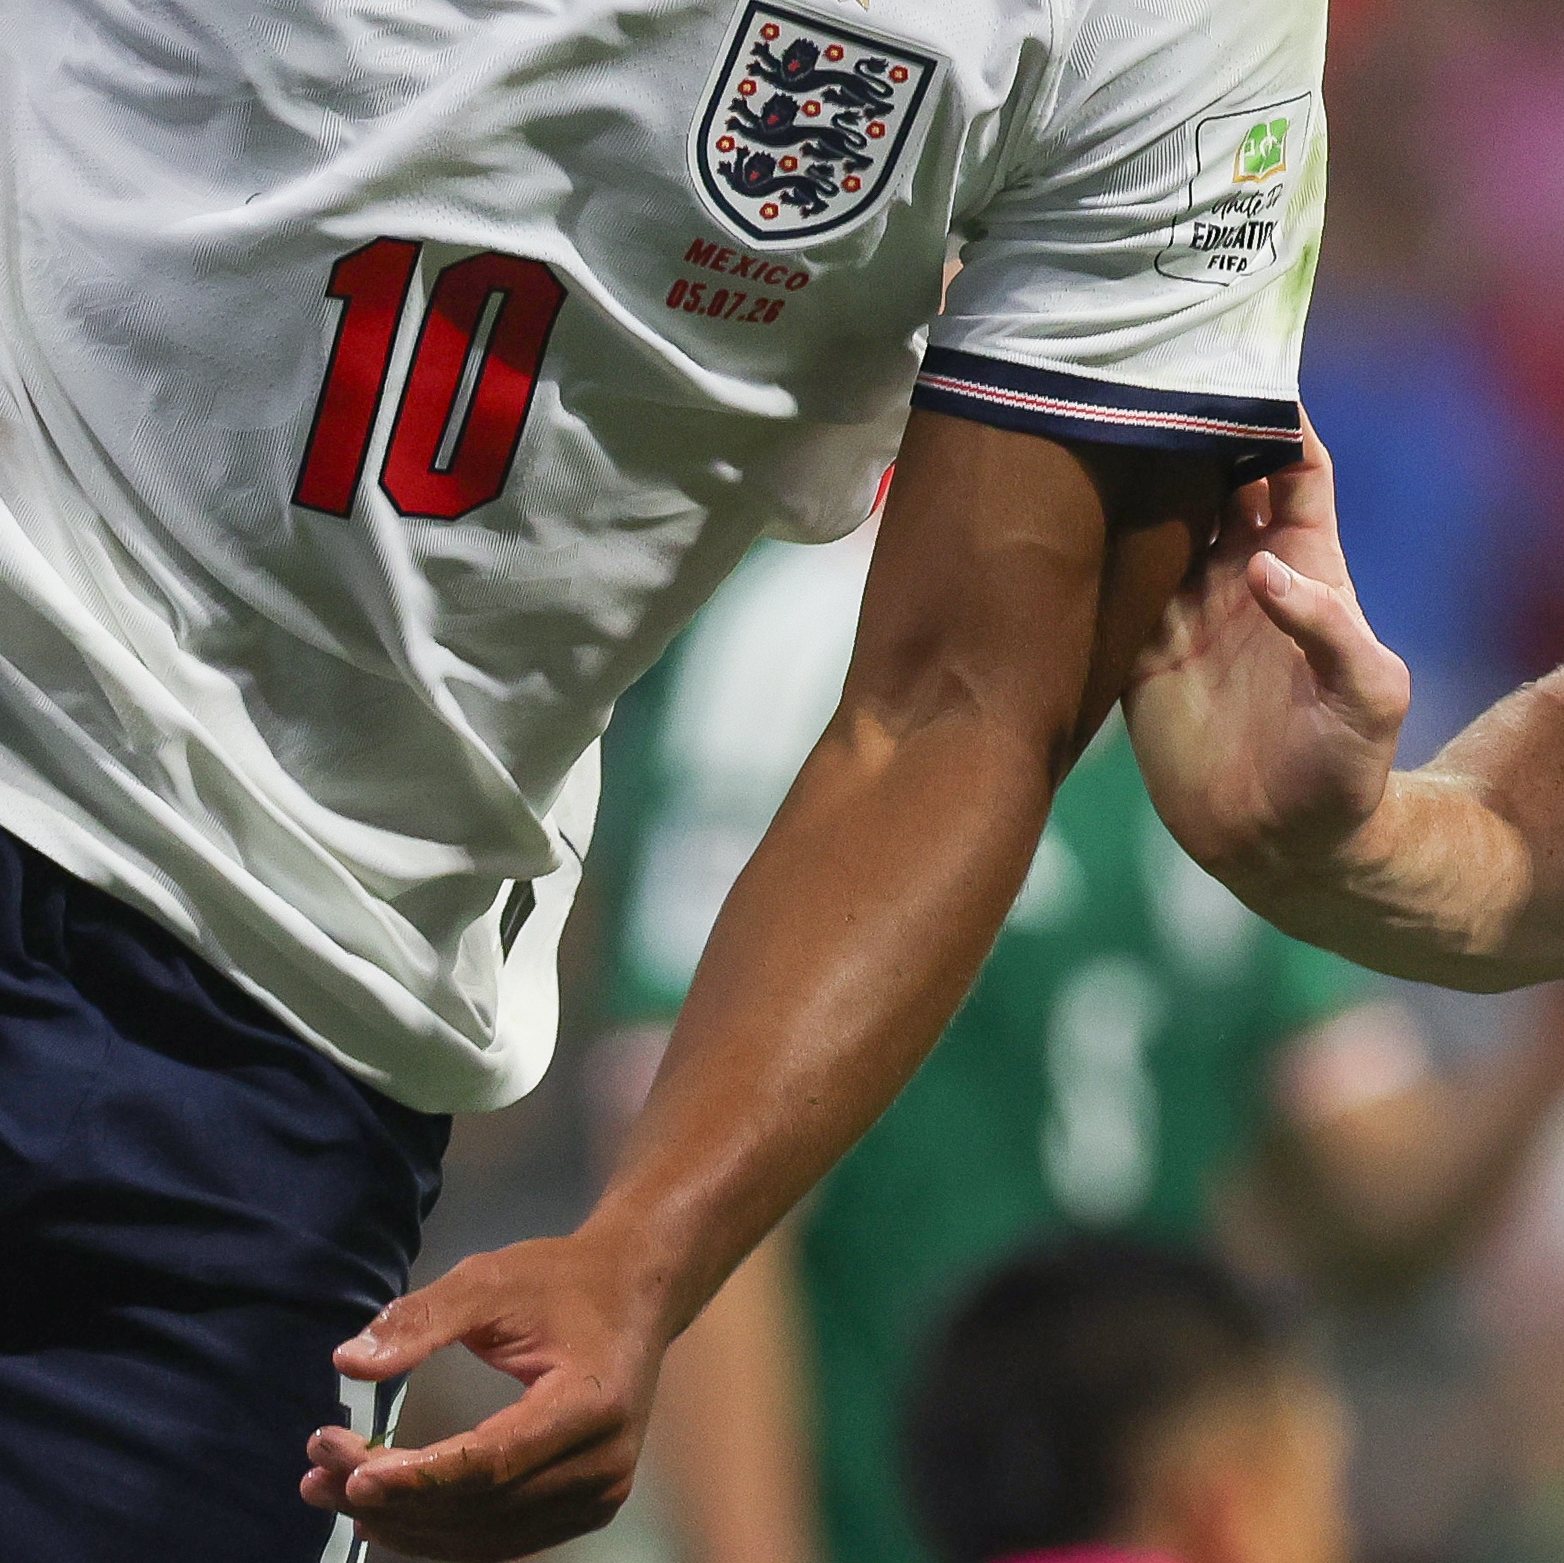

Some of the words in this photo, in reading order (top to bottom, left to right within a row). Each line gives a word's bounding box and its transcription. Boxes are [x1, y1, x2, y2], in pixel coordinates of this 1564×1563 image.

[684, 238, 810, 291] MEXICO
[1207, 254, 1248, 273] FIFA
[666, 279, 786, 324] 05.07.26
[290, 236, 569, 521] 10
